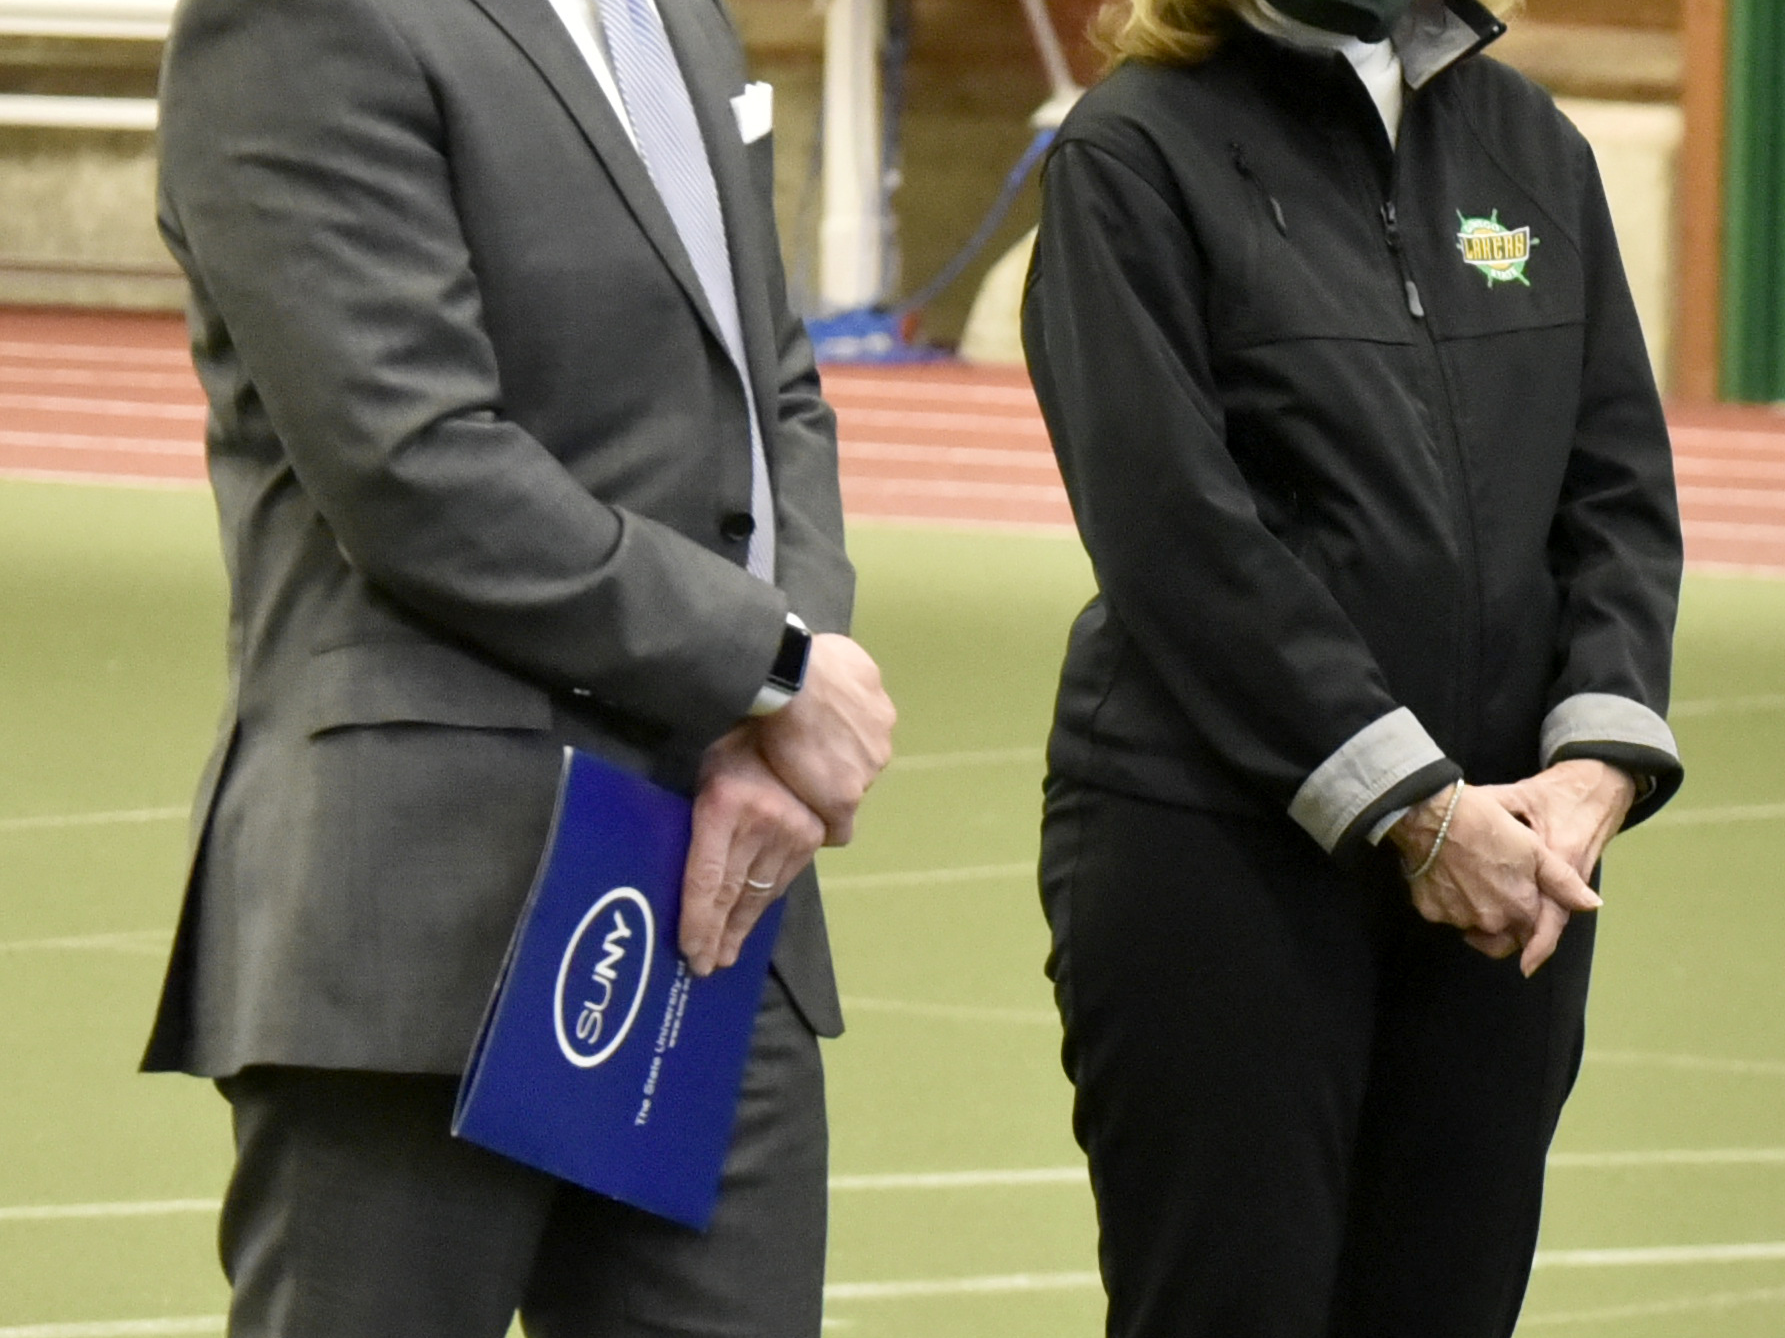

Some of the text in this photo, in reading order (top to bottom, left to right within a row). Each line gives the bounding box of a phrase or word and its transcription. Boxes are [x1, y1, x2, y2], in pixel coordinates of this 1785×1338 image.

[1463, 232, 1524, 260] LAKERS
[576, 910, 632, 1044] SUNY
[635, 1098, 651, 1126] The
